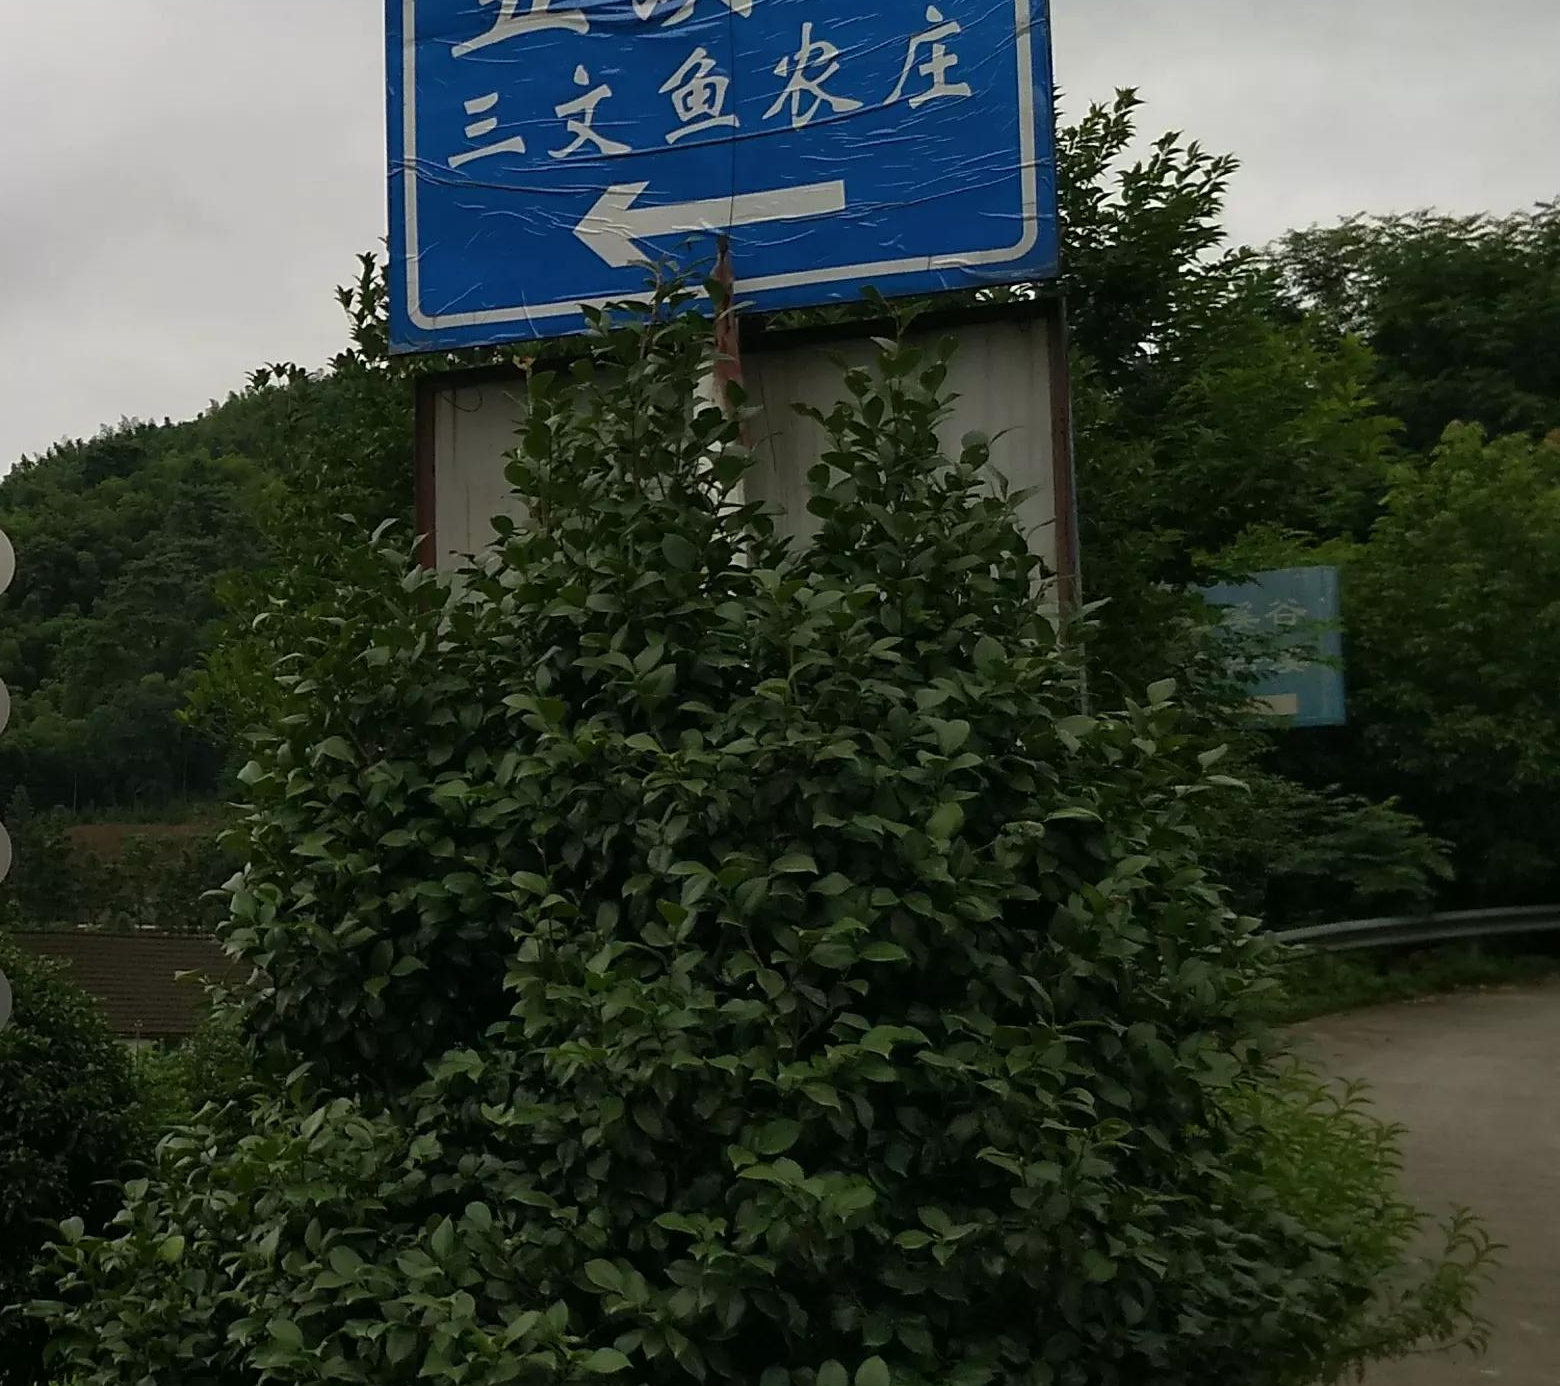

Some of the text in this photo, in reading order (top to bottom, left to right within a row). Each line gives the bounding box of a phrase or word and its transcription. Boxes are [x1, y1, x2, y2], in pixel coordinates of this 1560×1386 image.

[448, 5, 972, 168] 三文鱼农庄
